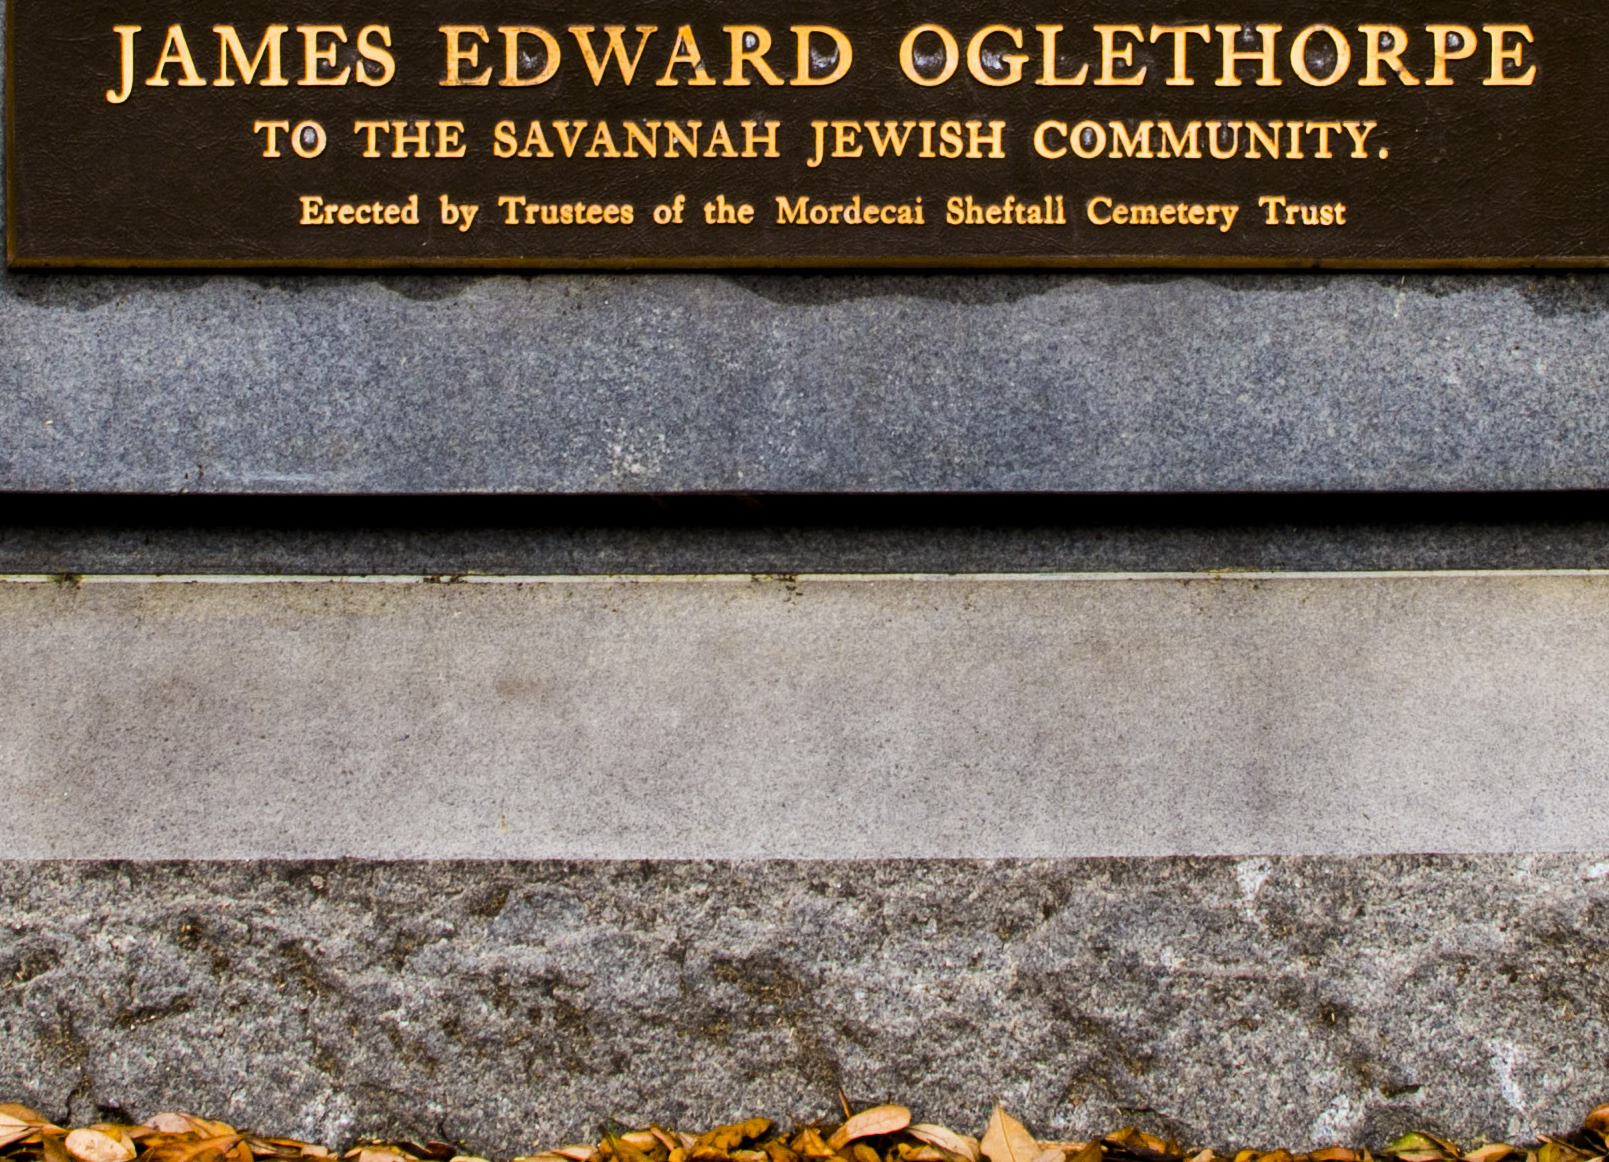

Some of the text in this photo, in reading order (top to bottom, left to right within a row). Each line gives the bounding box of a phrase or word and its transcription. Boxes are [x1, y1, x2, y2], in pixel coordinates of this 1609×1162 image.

[104, 22, 1538, 104] JAMES EDWARD OGLETHORPE
[252, 119, 1390, 168] TO THE SAVANNAH JEWISH COMMUNITY.
[297, 193, 1348, 233] Erected by Trustees of the Mordecai Sheftall Cemetery Trust
